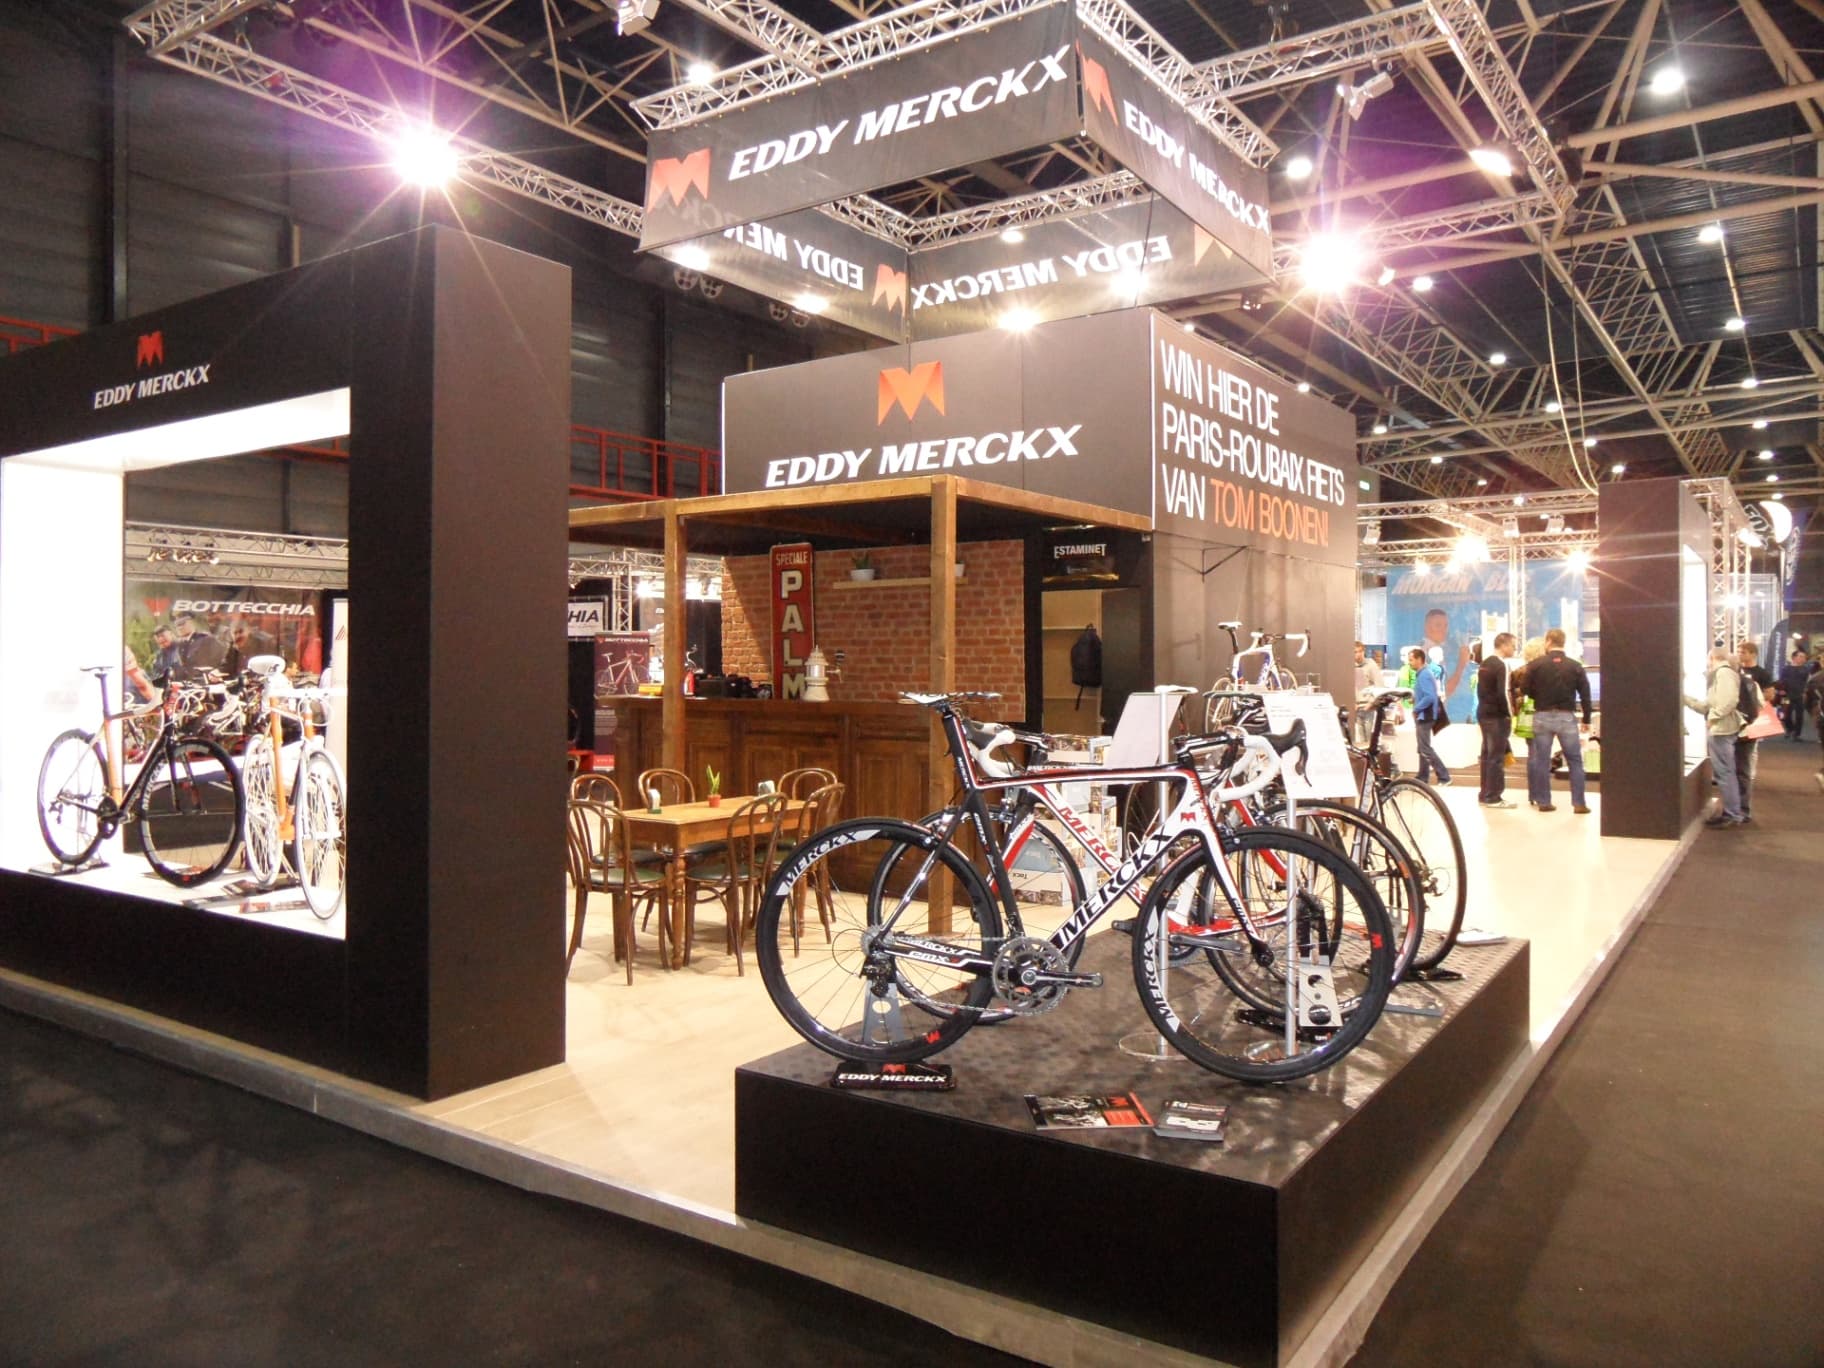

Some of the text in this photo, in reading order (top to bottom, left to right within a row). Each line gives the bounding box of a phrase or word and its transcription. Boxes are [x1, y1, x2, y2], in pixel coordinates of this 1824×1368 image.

[728, 44, 1071, 181] EDDY MERCKX
[1123, 99, 1271, 236] EDDY MERCKX
[94, 364, 211, 409] EDDY MERCKX
[1160, 339, 1280, 436] WIN HIER DE
[765, 424, 1082, 488] EDDY MERCKX
[1163, 402, 1345, 507] PARIS-ROUBAIX FIETS
[1162, 463, 1329, 548] VAN TOM BOONEN!
[775, 551, 809, 566] SPECIALE
[1054, 543, 1107, 559] ESTAMINET
[173, 599, 316, 617] BOTTECCHIA
[567, 609, 599, 623] HIA
[780, 570, 806, 700] PALM
[784, 831, 857, 889] MERCKX
[1062, 823, 1174, 944] MERCKX
[838, 1072, 947, 1083] EDDY MERCKX
